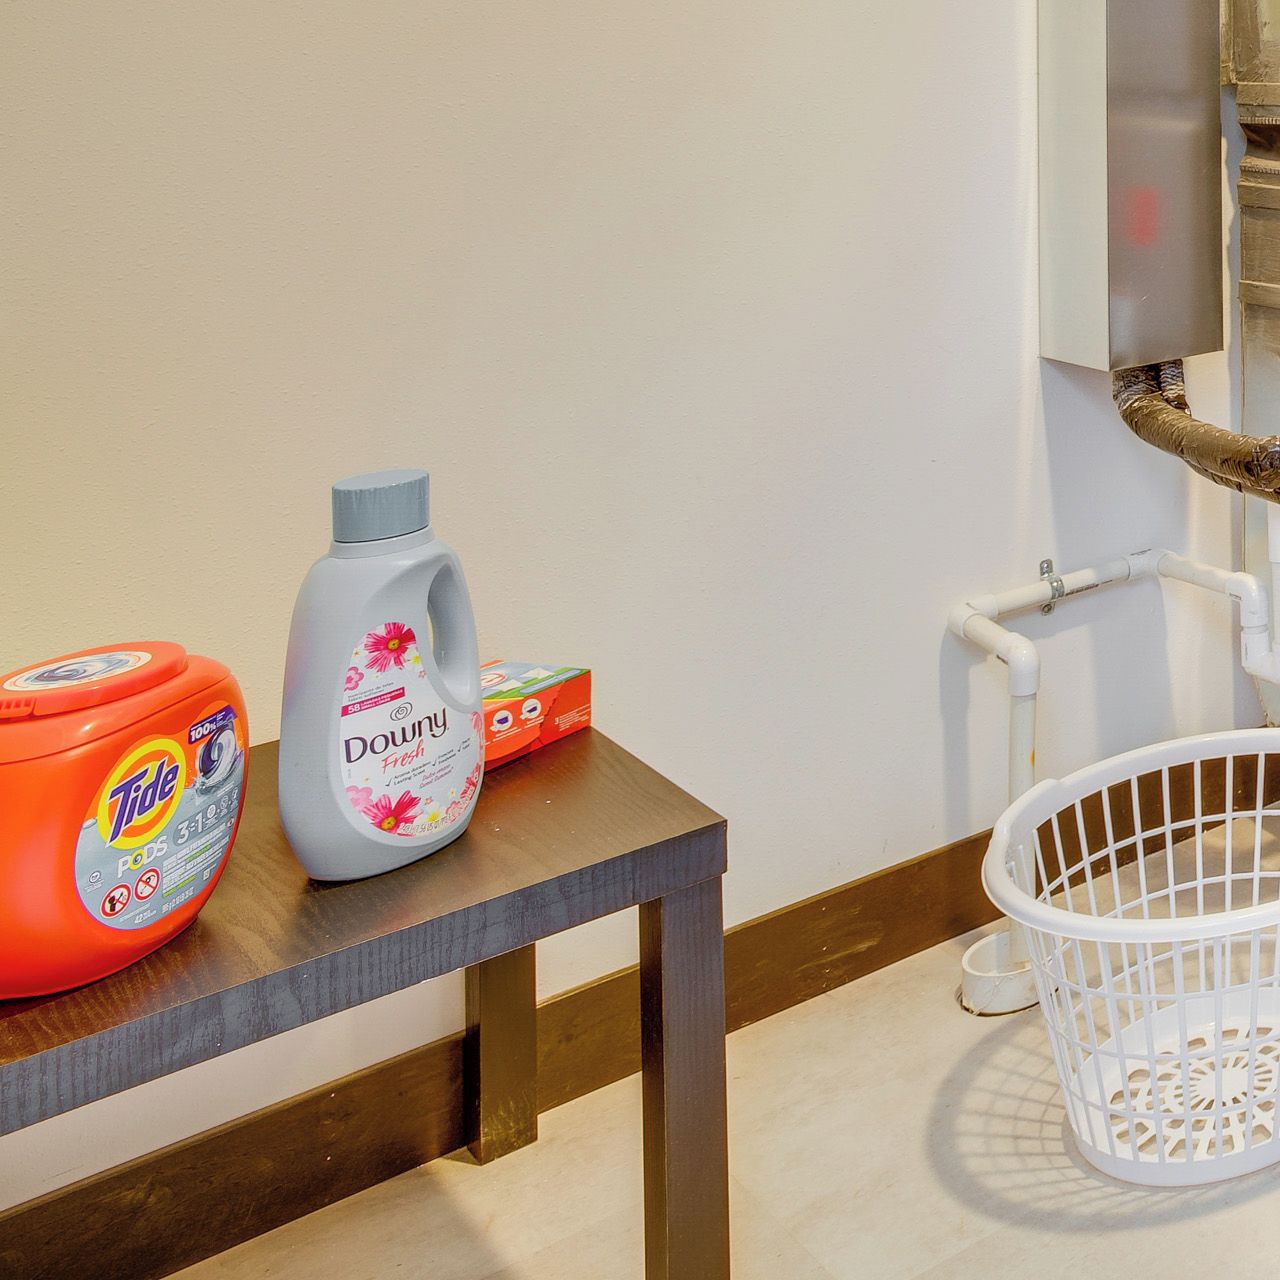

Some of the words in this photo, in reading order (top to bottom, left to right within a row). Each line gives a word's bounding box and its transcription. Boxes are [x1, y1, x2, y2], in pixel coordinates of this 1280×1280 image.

[348, 703, 361, 714] 58
[190, 722, 217, 742] 100%
[344, 707, 448, 764] Downy
[381, 738, 425, 774] Fresh
[104, 754, 181, 848] Tide
[117, 835, 168, 878] PODS
